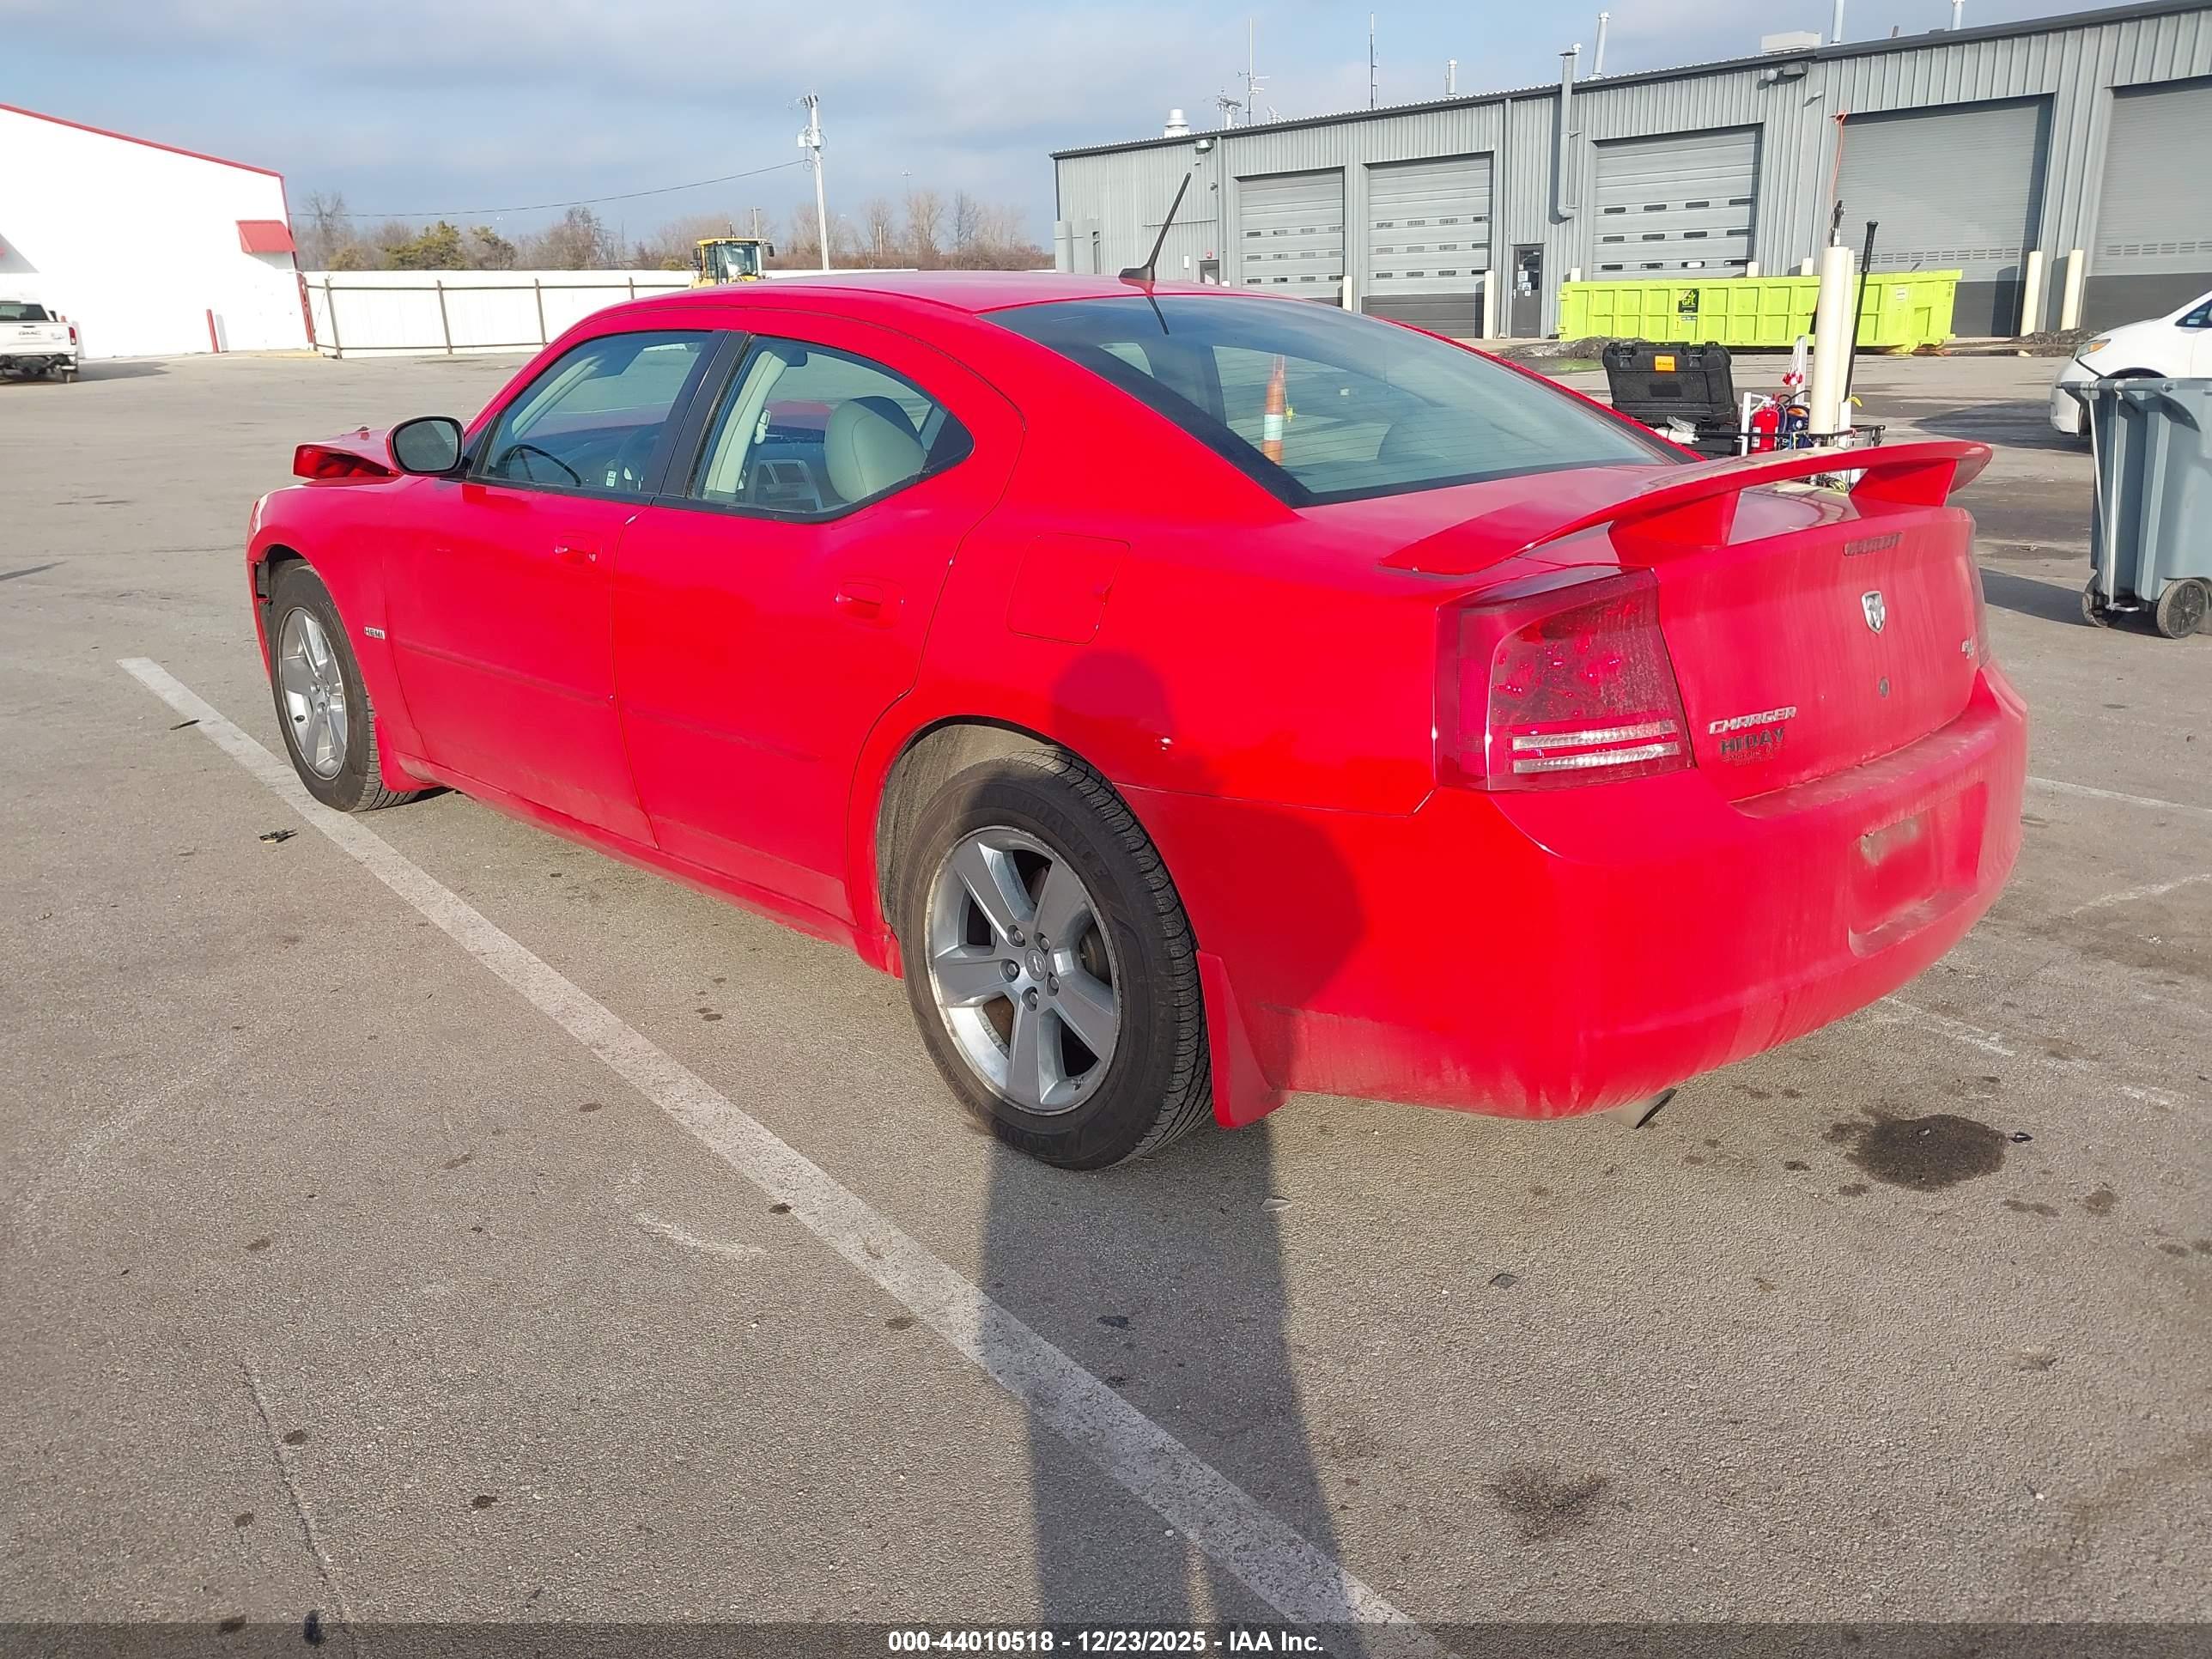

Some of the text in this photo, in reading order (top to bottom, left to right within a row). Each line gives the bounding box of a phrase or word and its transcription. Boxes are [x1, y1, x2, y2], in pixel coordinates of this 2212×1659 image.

[364, 626, 386, 640] HEMI
[1708, 706, 1797, 735] CHARGER
[1720, 726, 1786, 755] HIDAY
